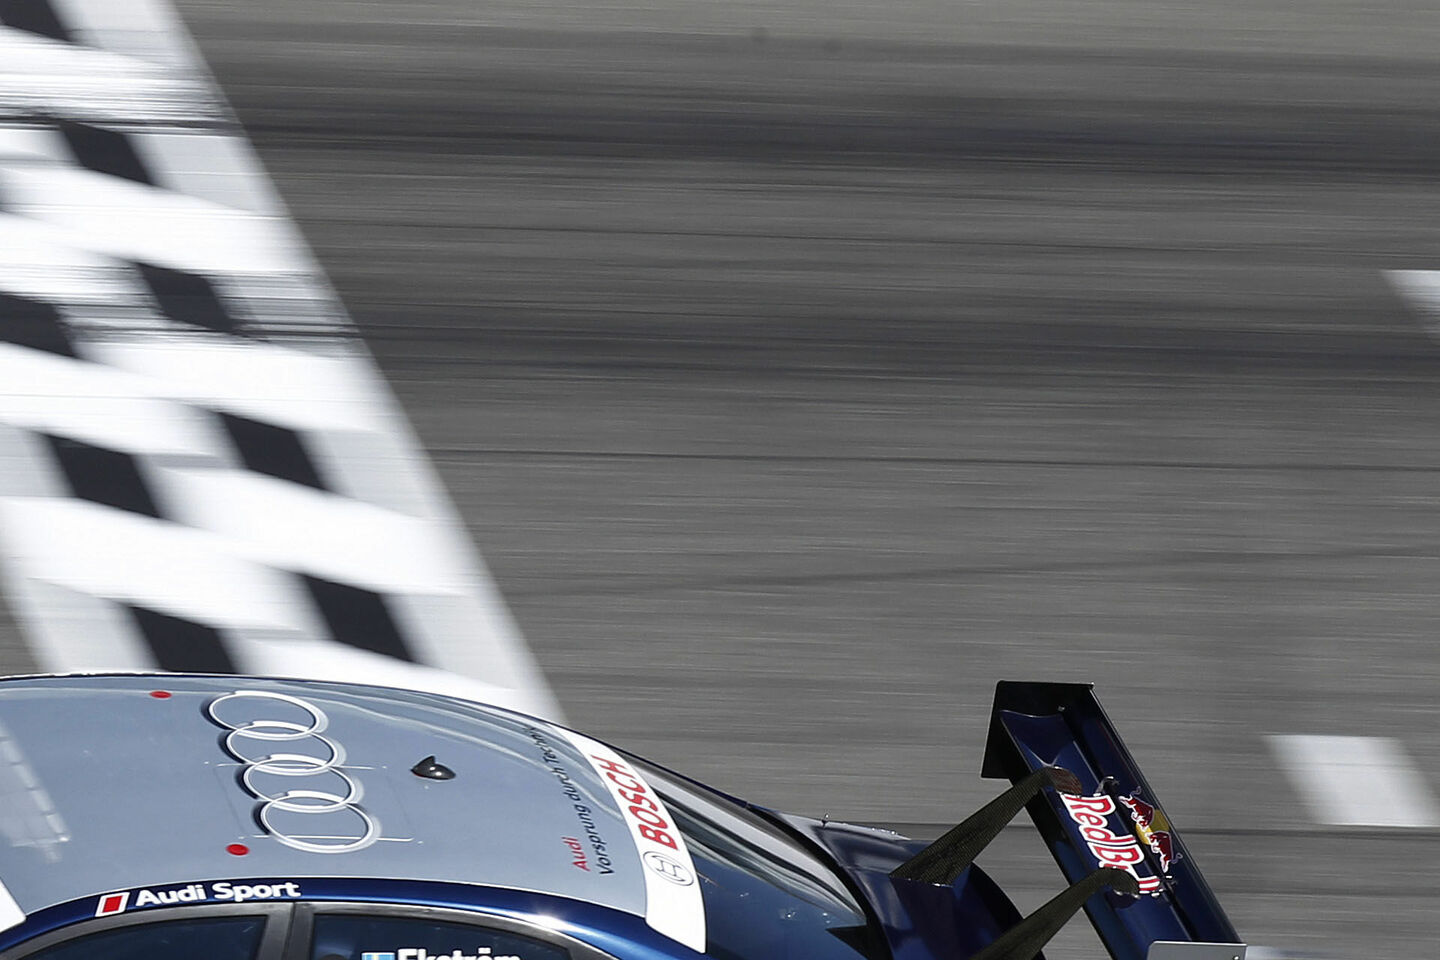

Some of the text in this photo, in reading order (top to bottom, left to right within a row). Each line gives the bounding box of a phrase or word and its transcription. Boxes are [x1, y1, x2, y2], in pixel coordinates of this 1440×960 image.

[551, 767, 581, 802] durch
[591, 755, 678, 851] BOSCH
[561, 836, 591, 872] Audi
[573, 804, 615, 875] Vorsprung
[135, 881, 302, 907] Audi Sport
